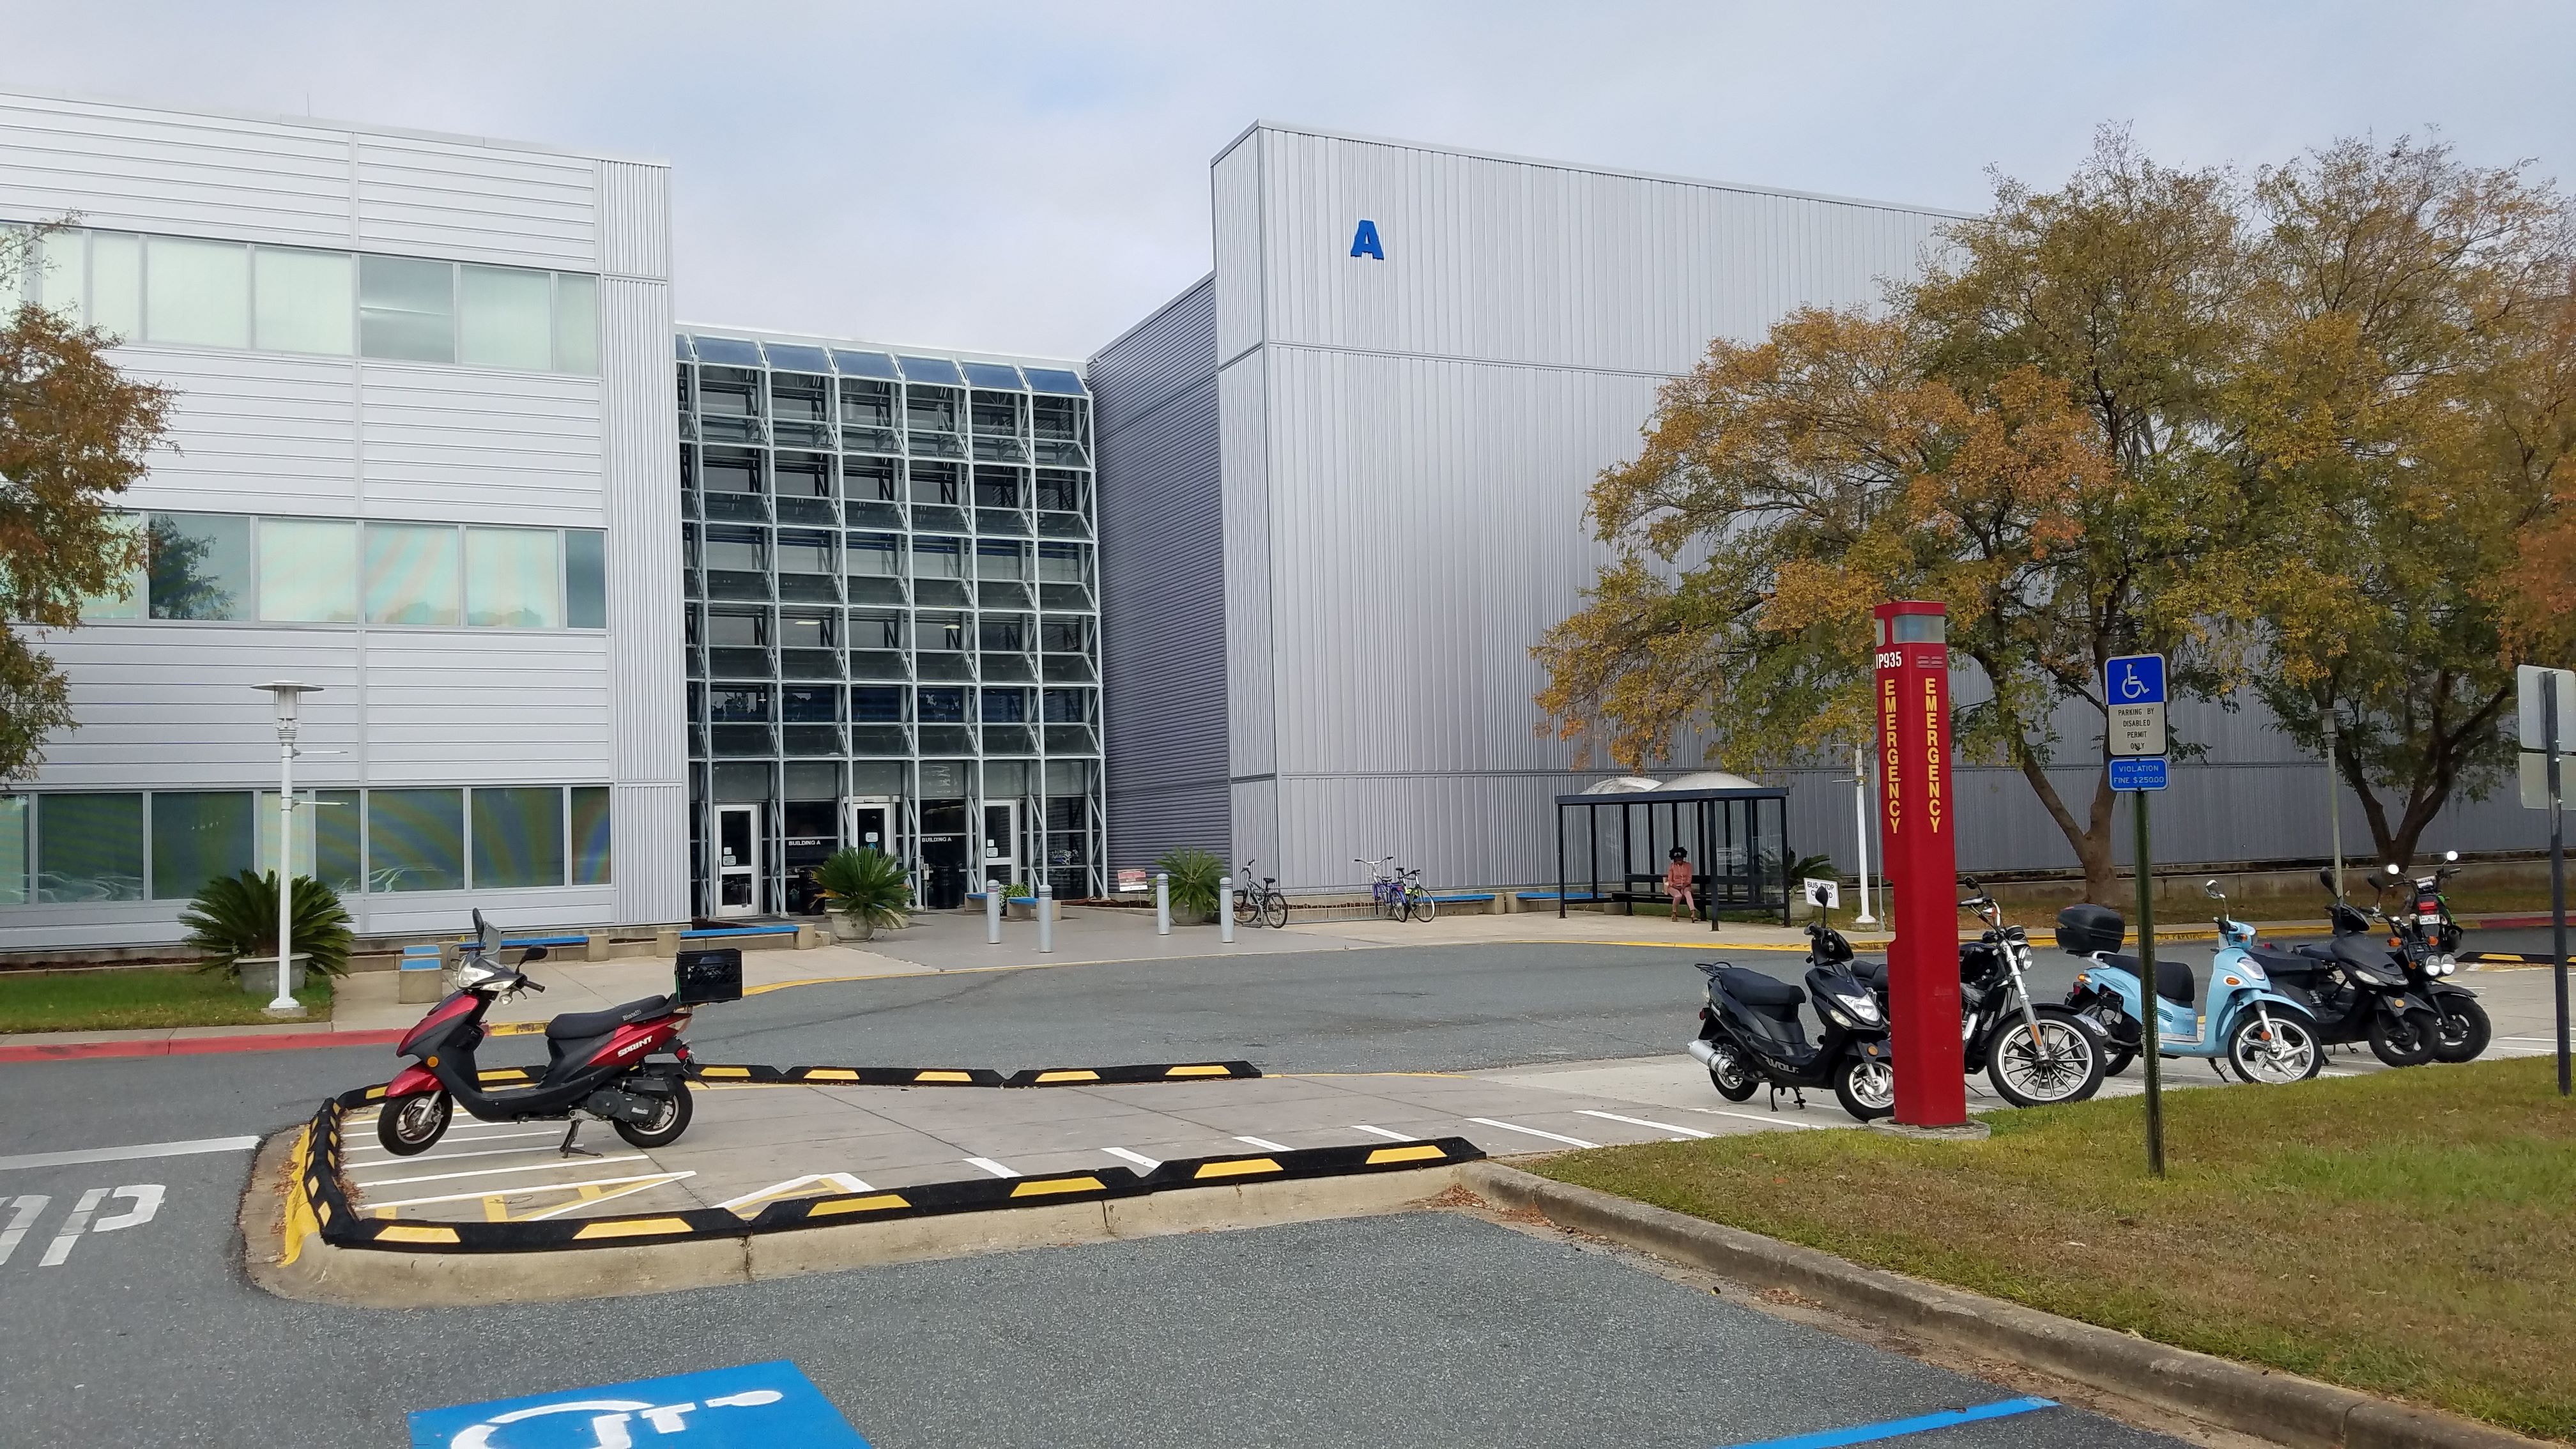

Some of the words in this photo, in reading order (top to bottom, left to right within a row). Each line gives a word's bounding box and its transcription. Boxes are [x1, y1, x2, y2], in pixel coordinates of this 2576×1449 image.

[1351, 220, 1384, 260] A
[1885, 678, 1901, 834] EMERGENCY
[1925, 678, 1941, 833] EMERGENCY
[617, 1036, 652, 1057] SPRINT
[1759, 1052, 1800, 1073] WOLF
